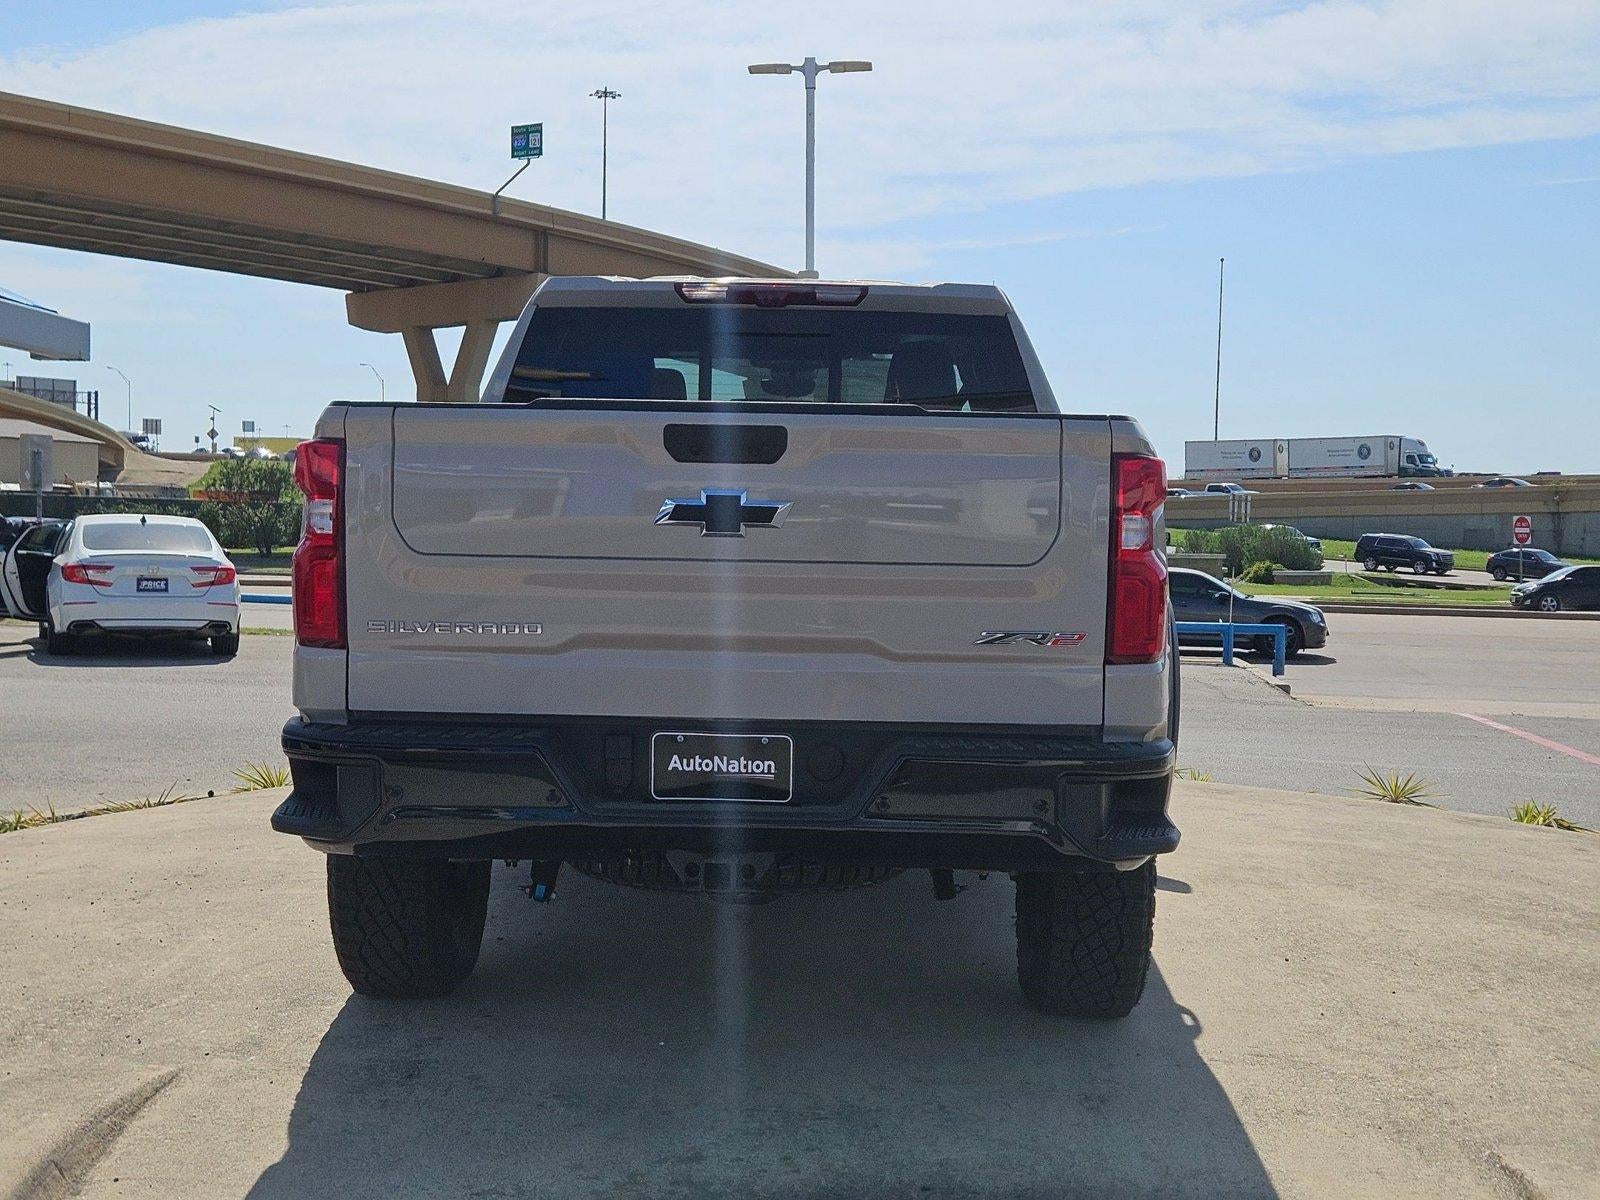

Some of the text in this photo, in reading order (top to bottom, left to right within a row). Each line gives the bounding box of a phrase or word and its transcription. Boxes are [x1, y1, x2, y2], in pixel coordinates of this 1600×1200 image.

[530, 137, 540, 146] 121
[367, 620, 543, 635] SILVERADO
[972, 631, 1088, 647] ZR2
[668, 754, 776, 774] AutoNation
